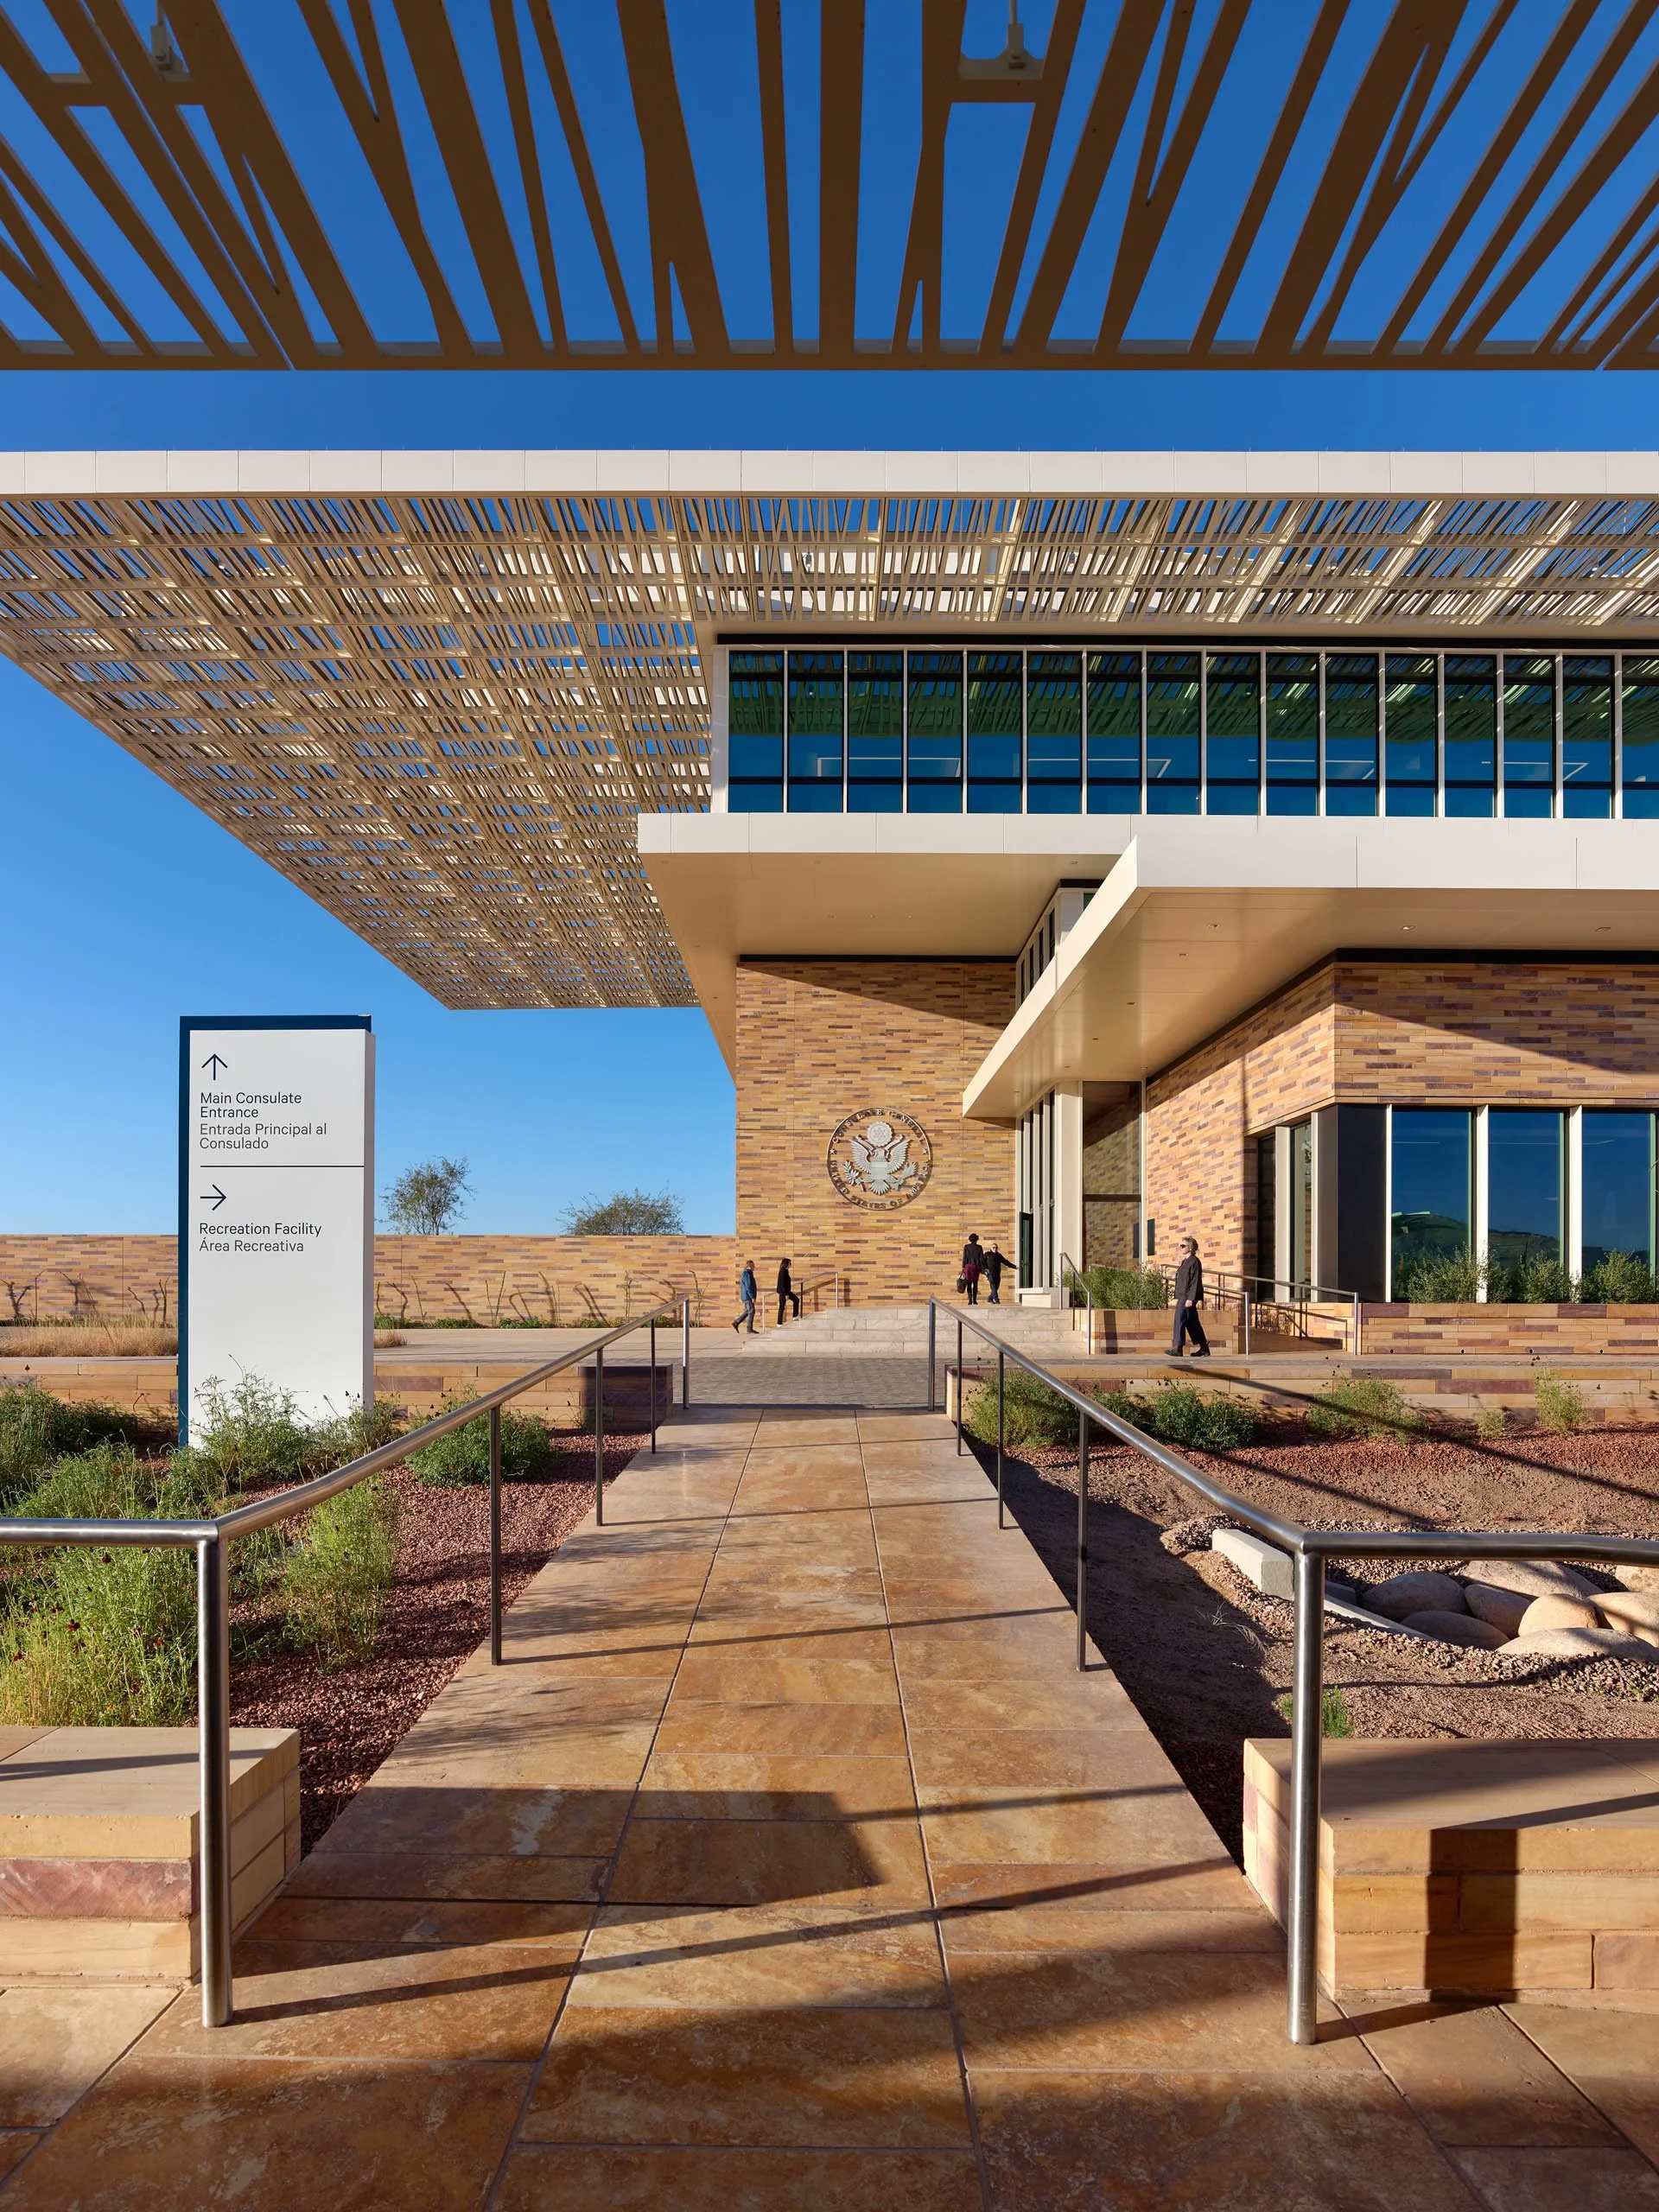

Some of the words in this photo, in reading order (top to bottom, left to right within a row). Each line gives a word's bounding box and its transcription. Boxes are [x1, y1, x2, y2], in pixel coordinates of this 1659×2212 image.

[200, 1091, 232, 1104] Main
[235, 1091, 302, 1104] Consulate
[200, 1106, 259, 1118] Entrance
[200, 1122, 251, 1135] Entrada
[255, 1122, 312, 1138] Principal
[315, 1122, 327, 1135] al
[199, 1137, 270, 1149] Consulado
[200, 1222, 270, 1235] Recreation
[275, 1222, 322, 1238] Facility
[199, 1236, 230, 1252] Área
[234, 1239, 304, 1252] Recreativa
